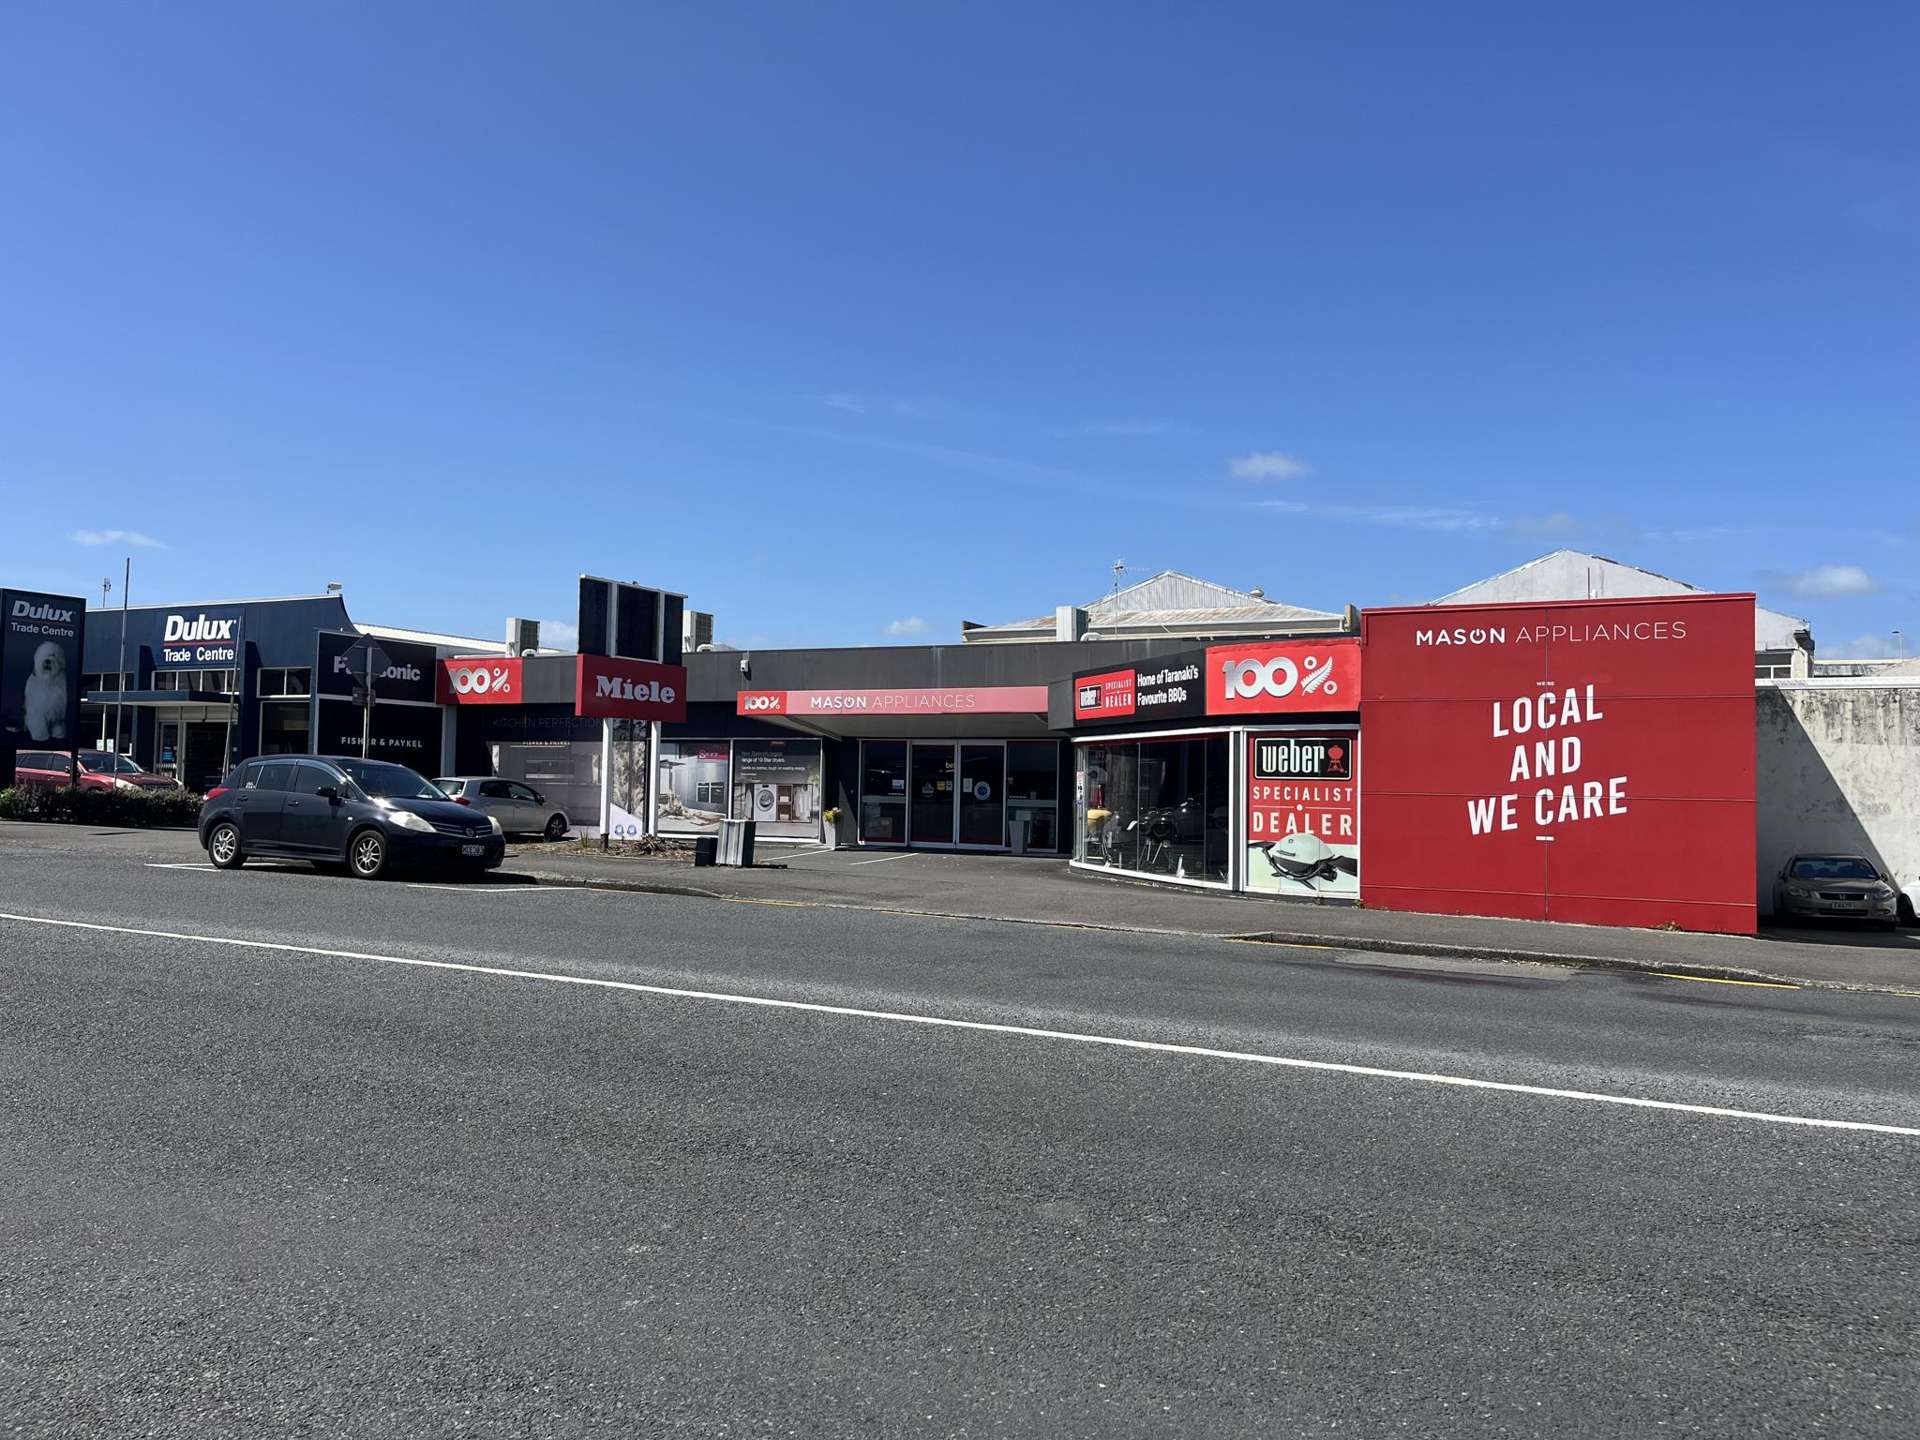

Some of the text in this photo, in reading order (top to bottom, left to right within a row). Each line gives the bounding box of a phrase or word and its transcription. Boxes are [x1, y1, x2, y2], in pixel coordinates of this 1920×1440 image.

[11, 600, 73, 622] Dulux
[11, 622, 74, 637] Trade Centre
[164, 613, 233, 641] Dulux
[1416, 621, 1687, 647] MASON APPLIANCES
[163, 646, 234, 662] Trade Centre
[1105, 679, 1132, 691] SPECIALIST
[1137, 665, 1199, 687] Home of Taranaki's
[1222, 656, 1337, 700] 100%
[595, 674, 675, 703] Miele
[1137, 687, 1187, 706] Favourite BBQs
[744, 696, 780, 711] 100%
[811, 694, 976, 709] MASON APPLIANCES
[1105, 693, 1132, 708] DEALER
[1492, 684, 1603, 737] LOCAL
[341, 736, 423, 748] FISHR & PAYKEL
[1262, 739, 1325, 773] weber
[1509, 735, 1581, 783] AND
[1252, 786, 1353, 802] SPECIALIST
[1467, 776, 1628, 837] WE CARE
[1252, 811, 1353, 836] DEALER
